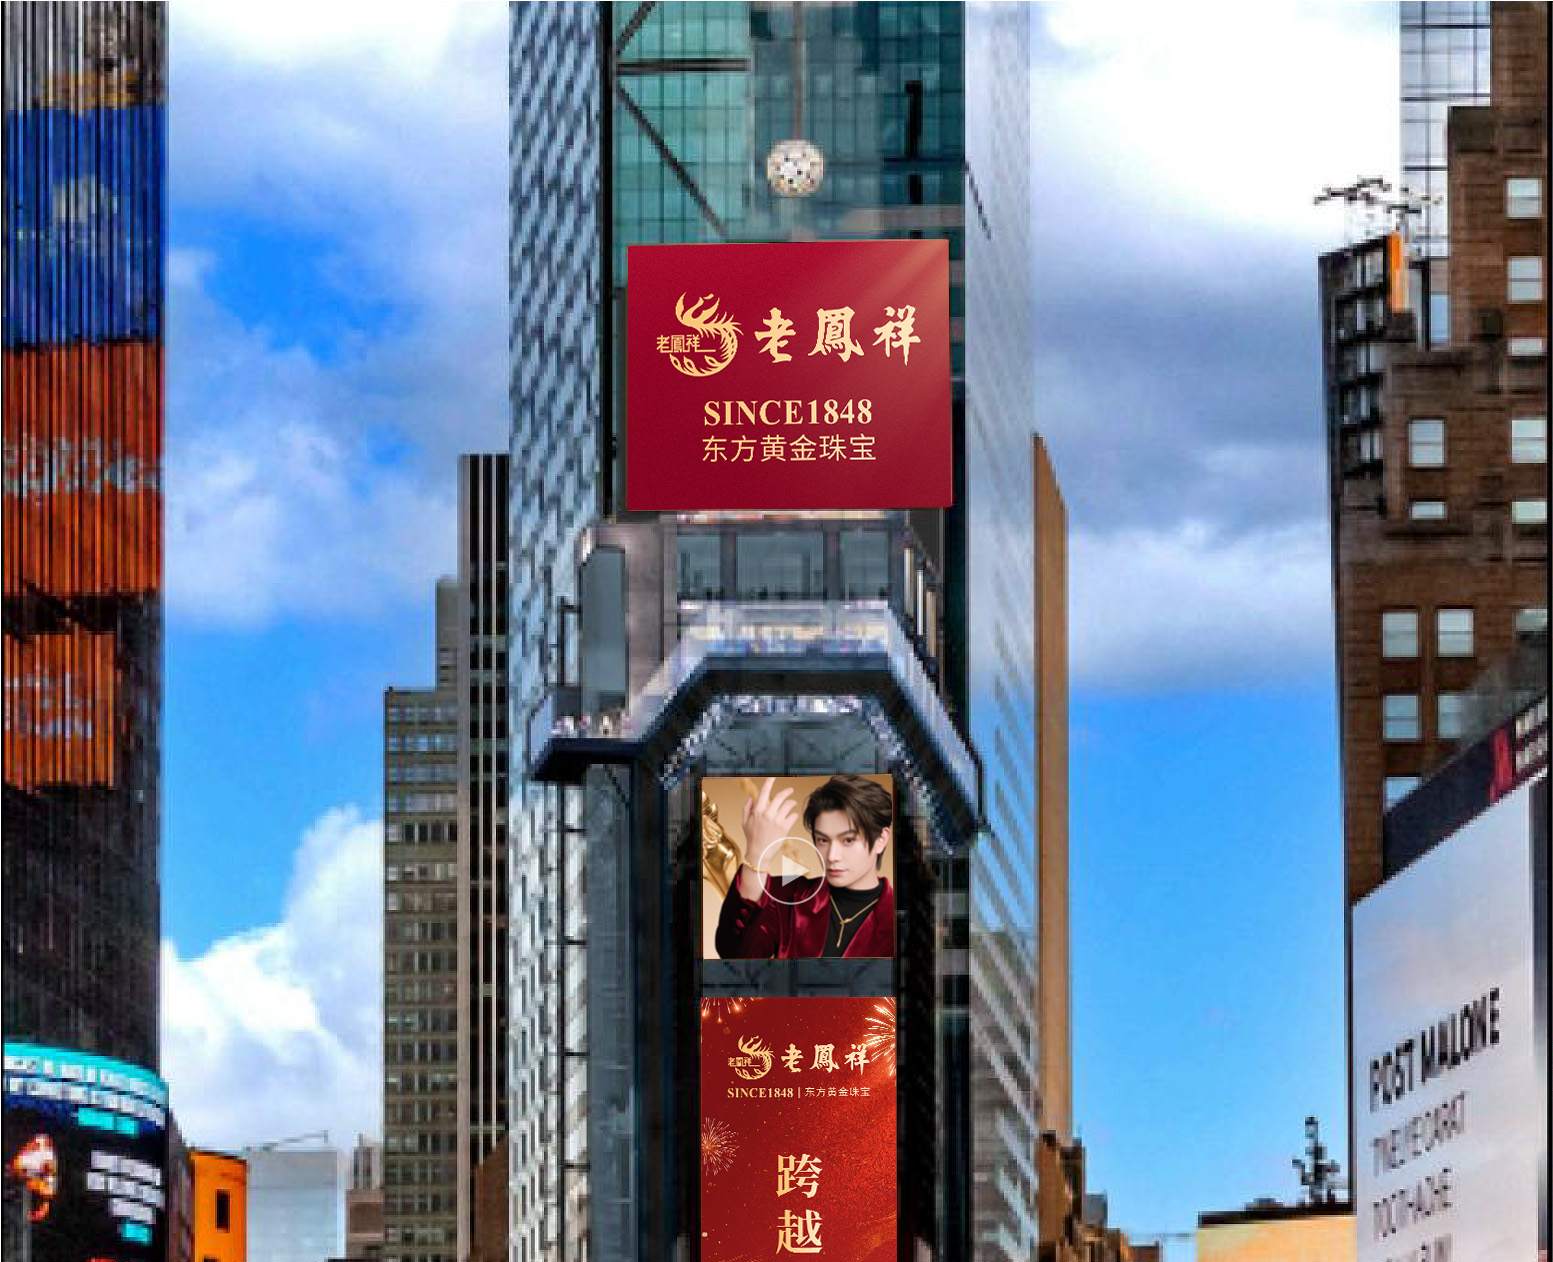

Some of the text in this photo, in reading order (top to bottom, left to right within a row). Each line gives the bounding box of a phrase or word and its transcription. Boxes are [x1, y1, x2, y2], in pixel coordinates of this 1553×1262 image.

[754, 305, 921, 366] 老鳳祥
[704, 399, 872, 426] SINCE1848
[702, 434, 876, 463] 东方黄金珠宝
[781, 1043, 870, 1075] 老鳳祥
[727, 1087, 794, 1098] SINCE1848
